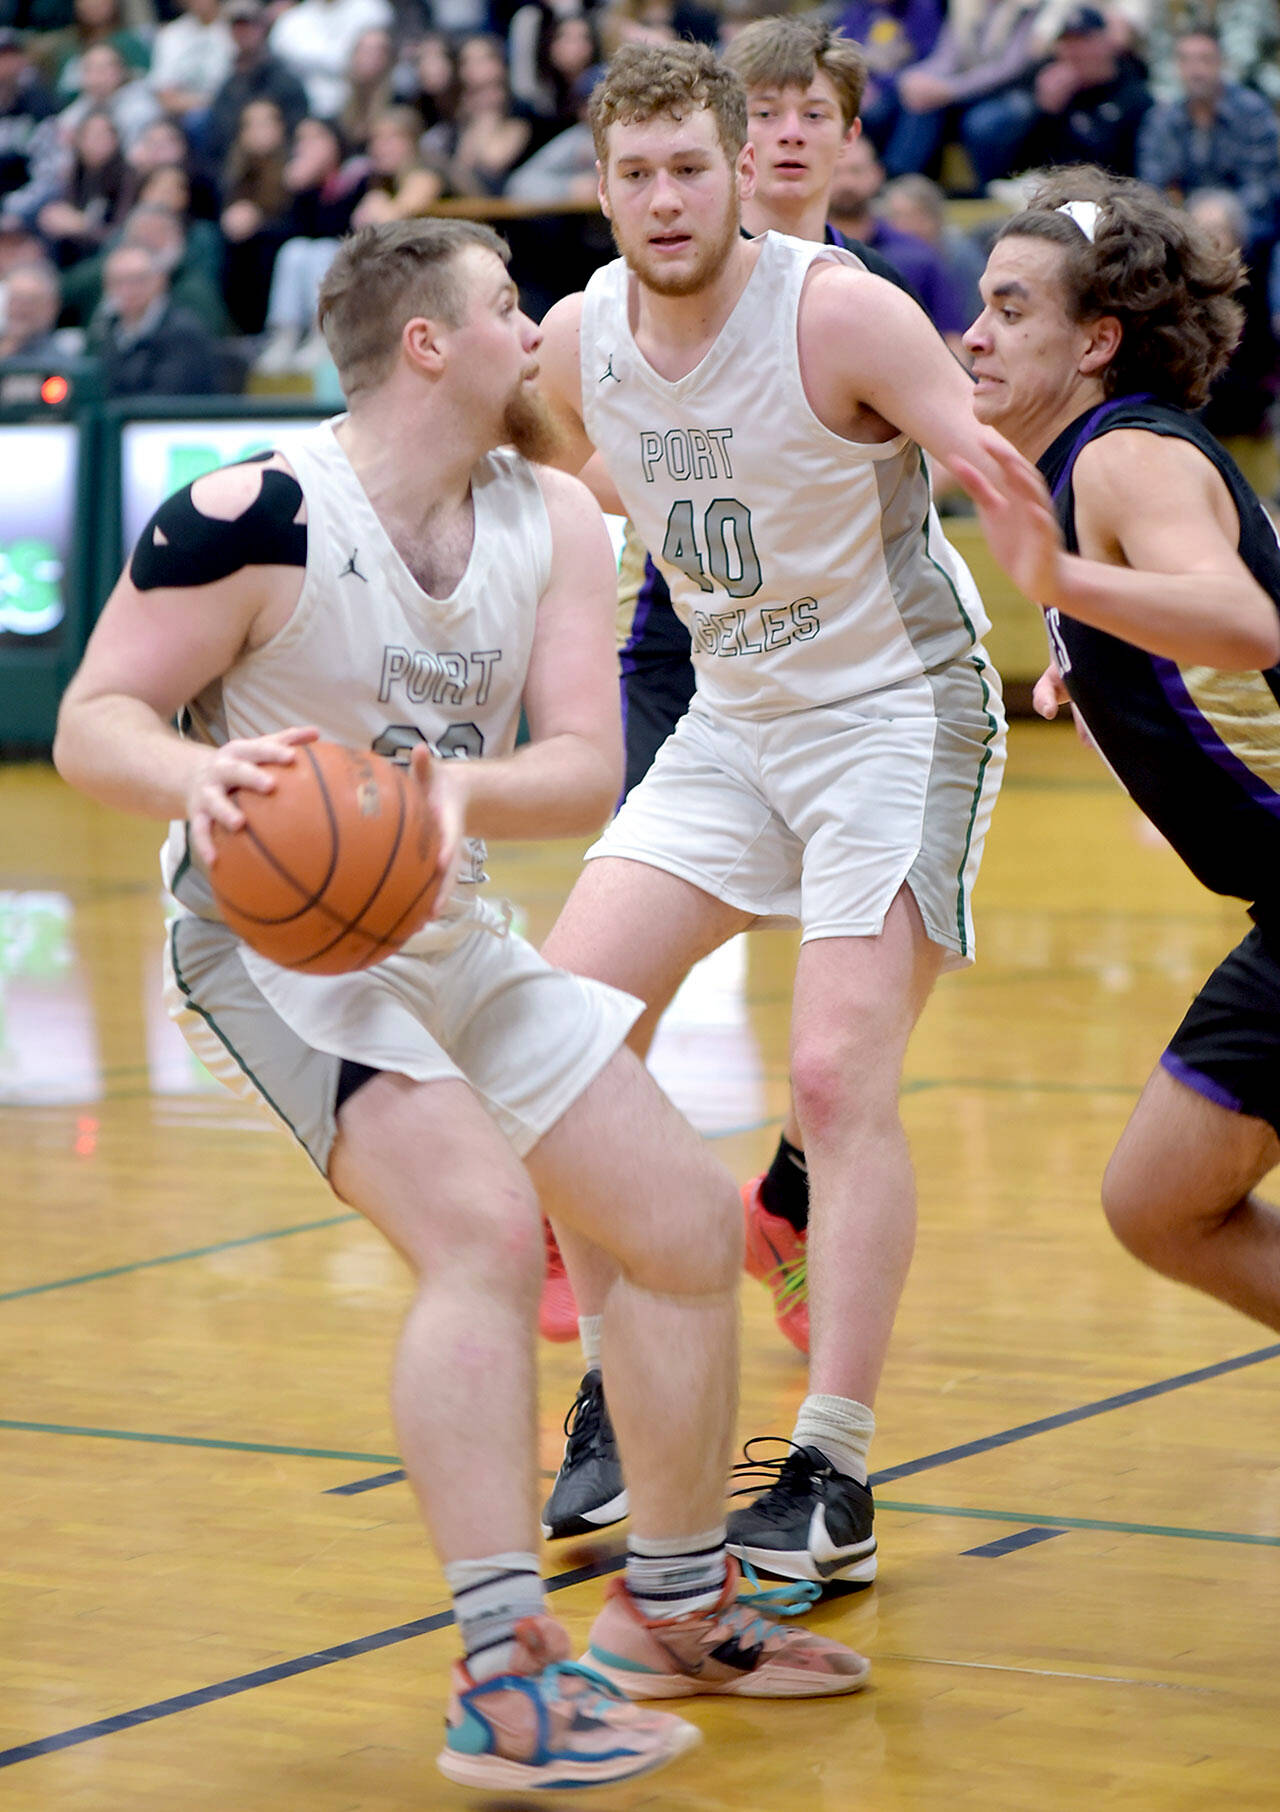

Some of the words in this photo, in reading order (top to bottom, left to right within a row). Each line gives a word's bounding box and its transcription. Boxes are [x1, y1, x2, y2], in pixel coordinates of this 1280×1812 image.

[640, 428, 733, 483] PORT
[661, 497, 763, 599] 40
[692, 596, 821, 658] GELES
[378, 644, 502, 706] PORT
